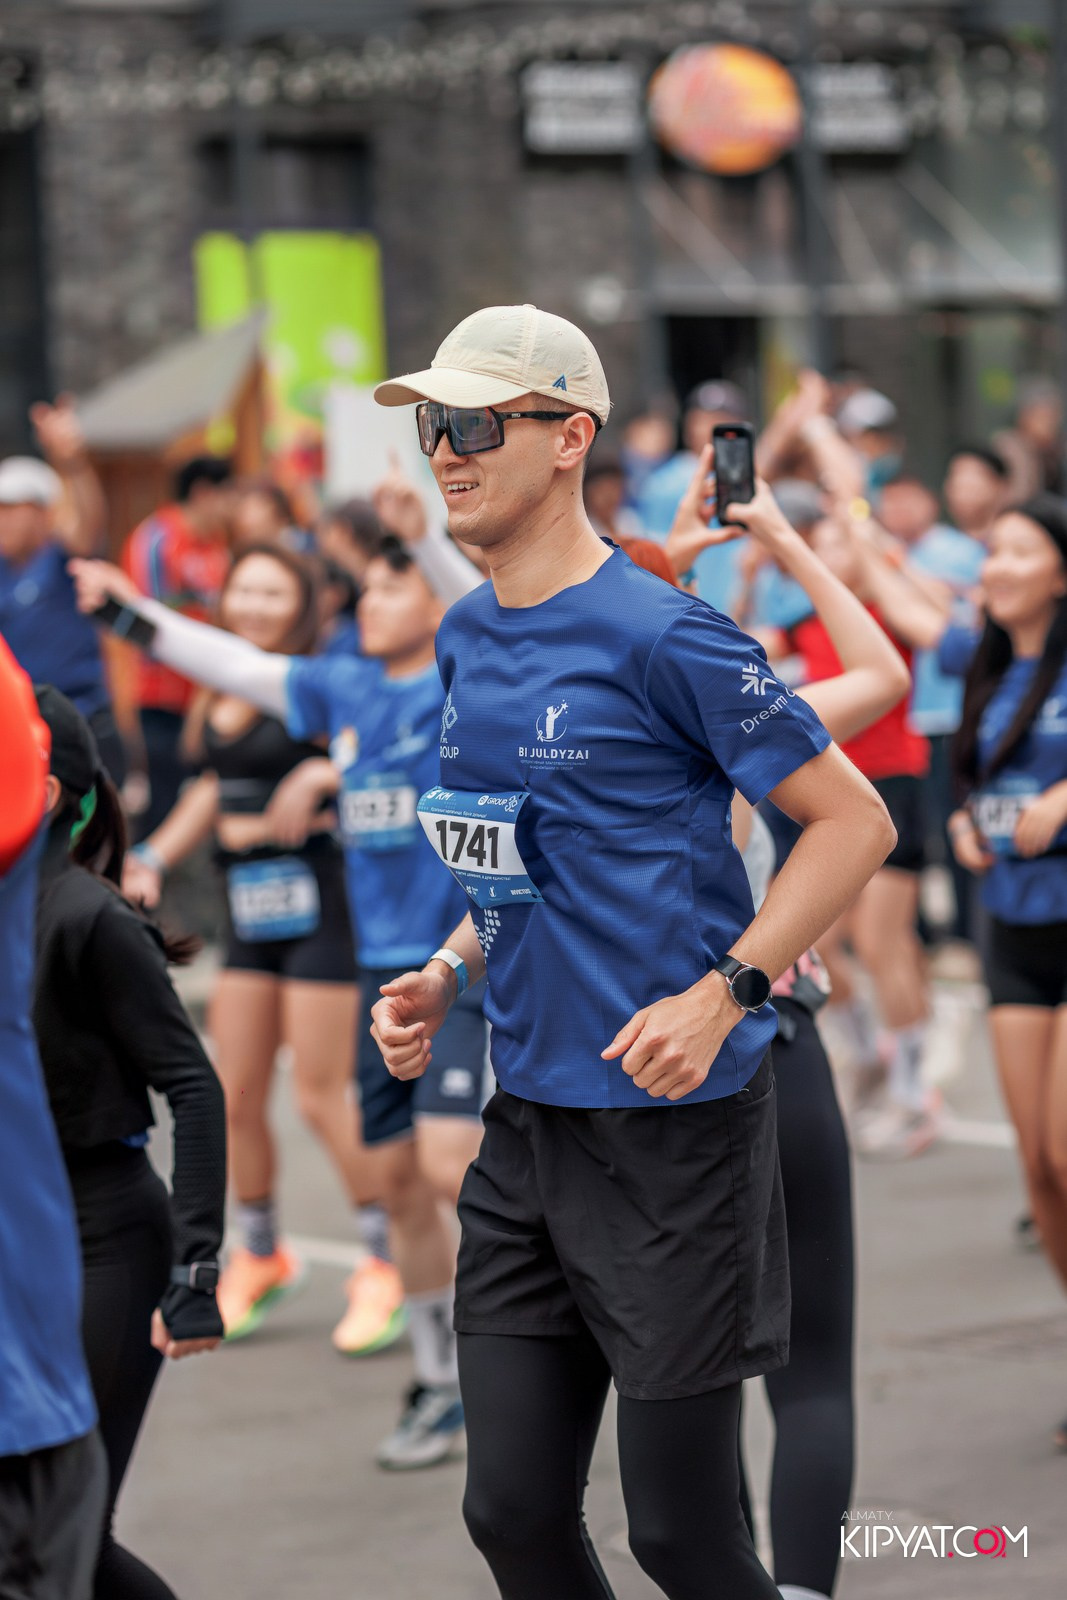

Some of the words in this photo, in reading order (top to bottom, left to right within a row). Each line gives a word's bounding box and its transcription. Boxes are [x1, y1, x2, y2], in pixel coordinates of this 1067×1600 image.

[740, 695, 788, 734] Dream
[518, 746, 528, 758] BI
[530, 747, 589, 760] JULDYZAI
[435, 791, 455, 801] KM
[486, 797, 508, 806] GROUP
[435, 819, 500, 869] 1741
